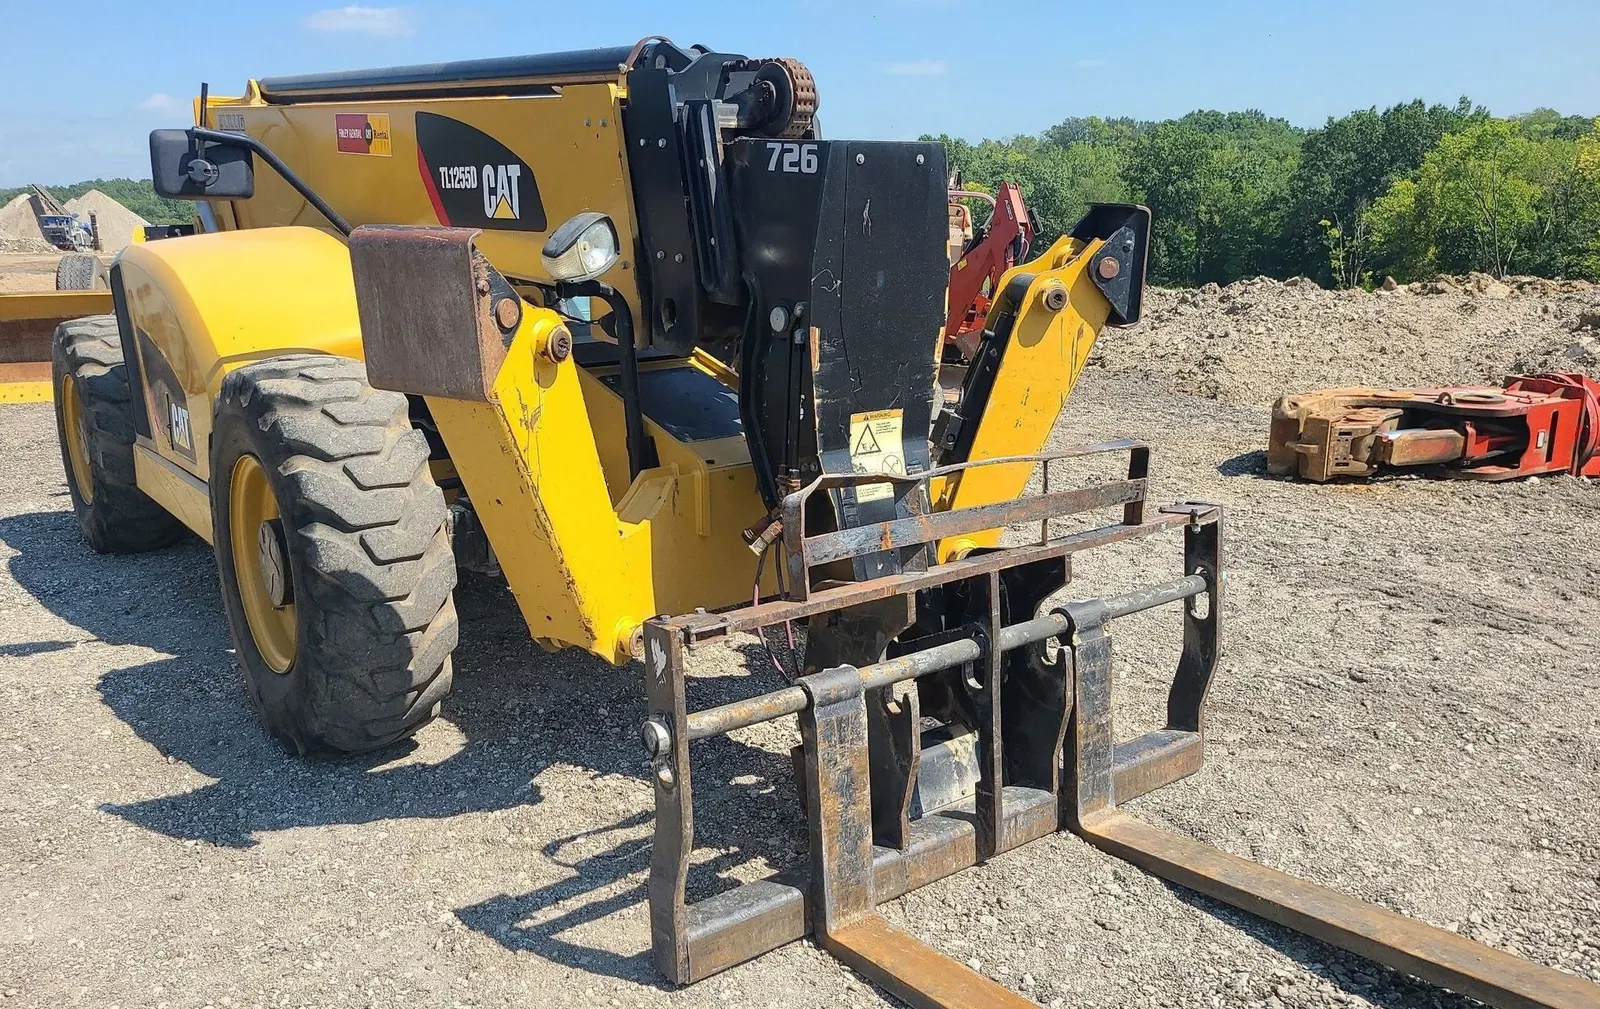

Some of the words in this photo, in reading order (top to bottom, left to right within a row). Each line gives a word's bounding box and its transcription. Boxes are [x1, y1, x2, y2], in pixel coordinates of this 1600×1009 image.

[373, 129, 389, 140] Rental
[766, 142, 818, 174] 726
[439, 165, 478, 189] TL1255D
[482, 164, 521, 219] CAT
[171, 402, 191, 451] CAT
[869, 411, 891, 419] WARNING
